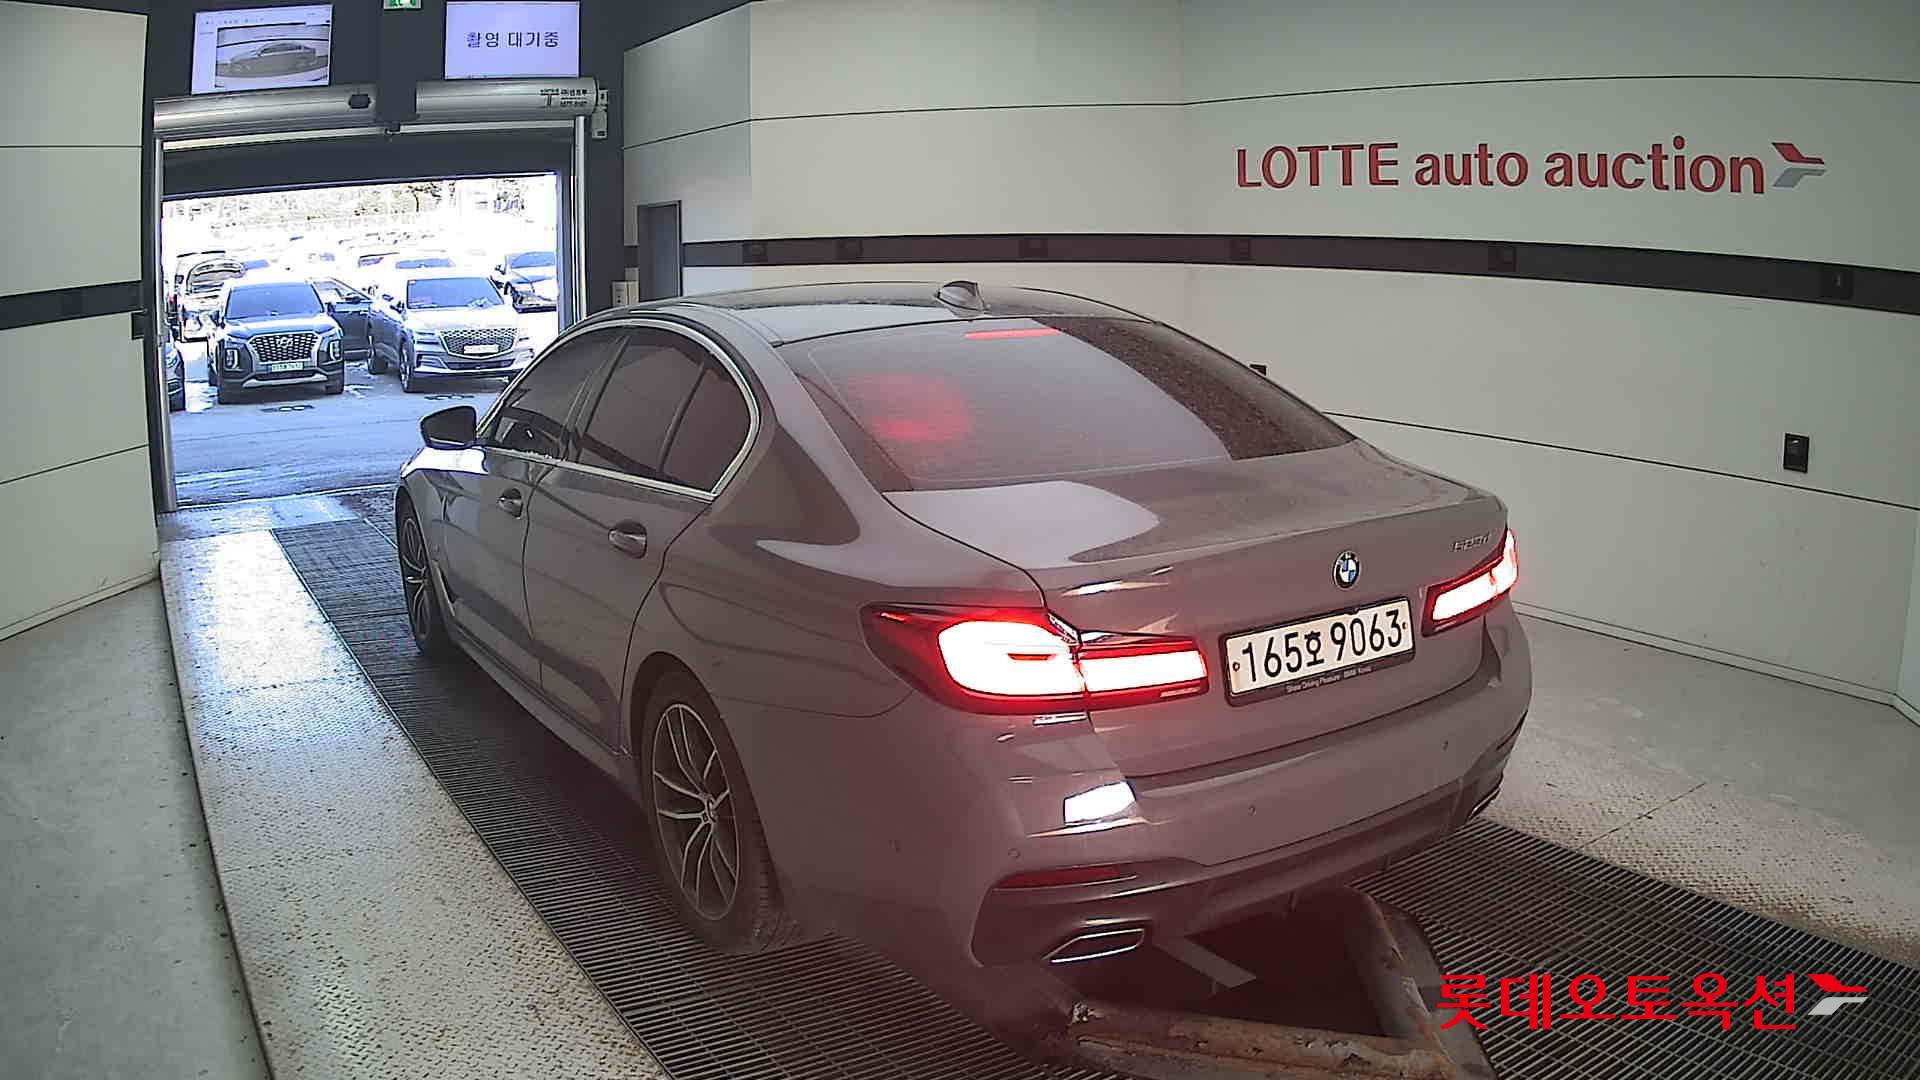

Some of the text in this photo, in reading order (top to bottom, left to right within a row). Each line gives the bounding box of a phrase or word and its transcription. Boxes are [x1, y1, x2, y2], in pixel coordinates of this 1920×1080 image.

[508, 31, 559, 48] 대기중
[1237, 135, 1765, 194] LOTTE auto auction
